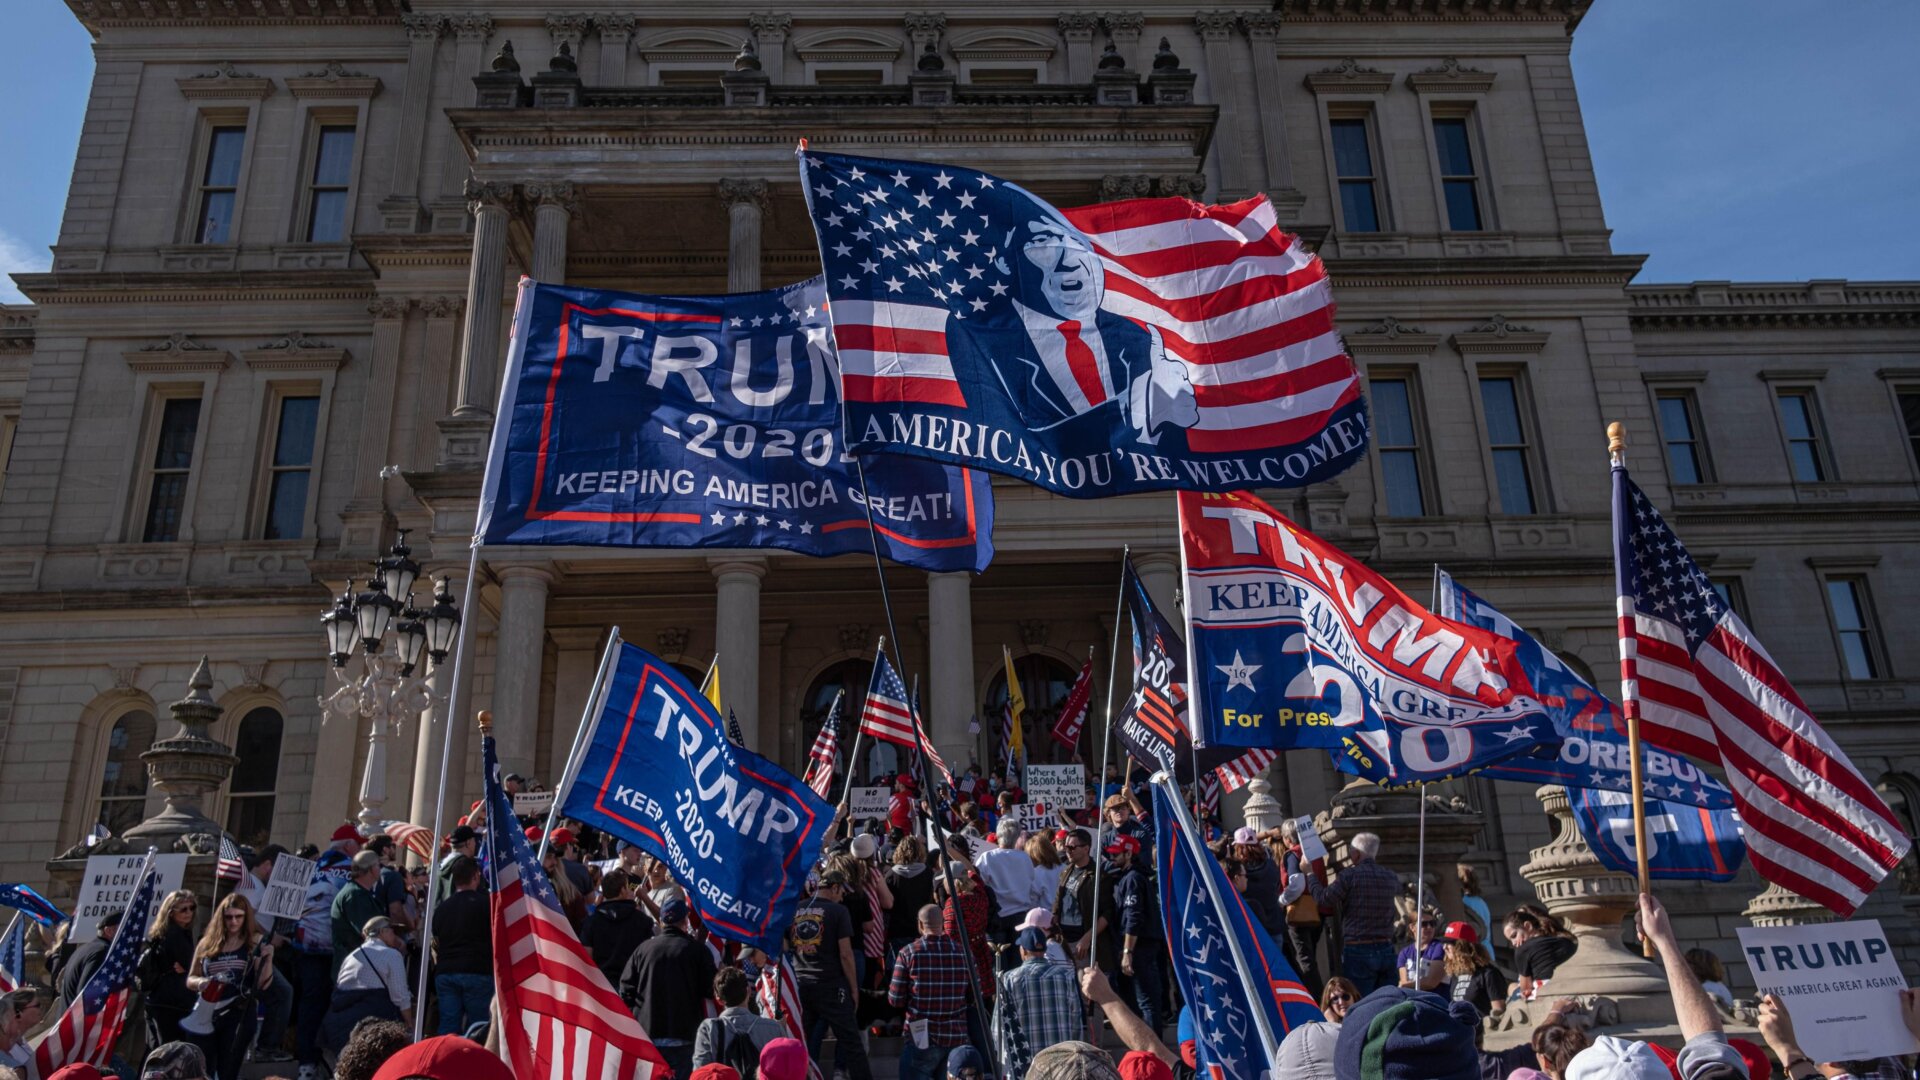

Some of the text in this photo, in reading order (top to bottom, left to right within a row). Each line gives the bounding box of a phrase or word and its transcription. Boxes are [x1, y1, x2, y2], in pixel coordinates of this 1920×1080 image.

[1181, 411, 1369, 485] WELCOME!
[556, 469, 952, 522] KEEPING AMERICA GREAT!
[1208, 581, 1309, 611] KEEP
[1308, 601, 1383, 704] AMERICA
[1229, 667, 1247, 679] '16
[1223, 709, 1264, 727] For
[1122, 715, 1151, 747] MAKE
[652, 683, 799, 844] TRUMP
[1028, 767, 1077, 777] Where did
[1056, 775, 1084, 786] ballots
[1056, 787, 1080, 796] from
[1019, 802, 1053, 817] STOP
[1019, 815, 1060, 830] STEAL
[614, 784, 762, 923] KEEP AMERICA GREAT!
[93, 873, 164, 886] MICHIN
[1746, 938, 1887, 972] TRUMP
[1761, 976, 1903, 997] MAKE AMERICA GREAT AGAIN!
